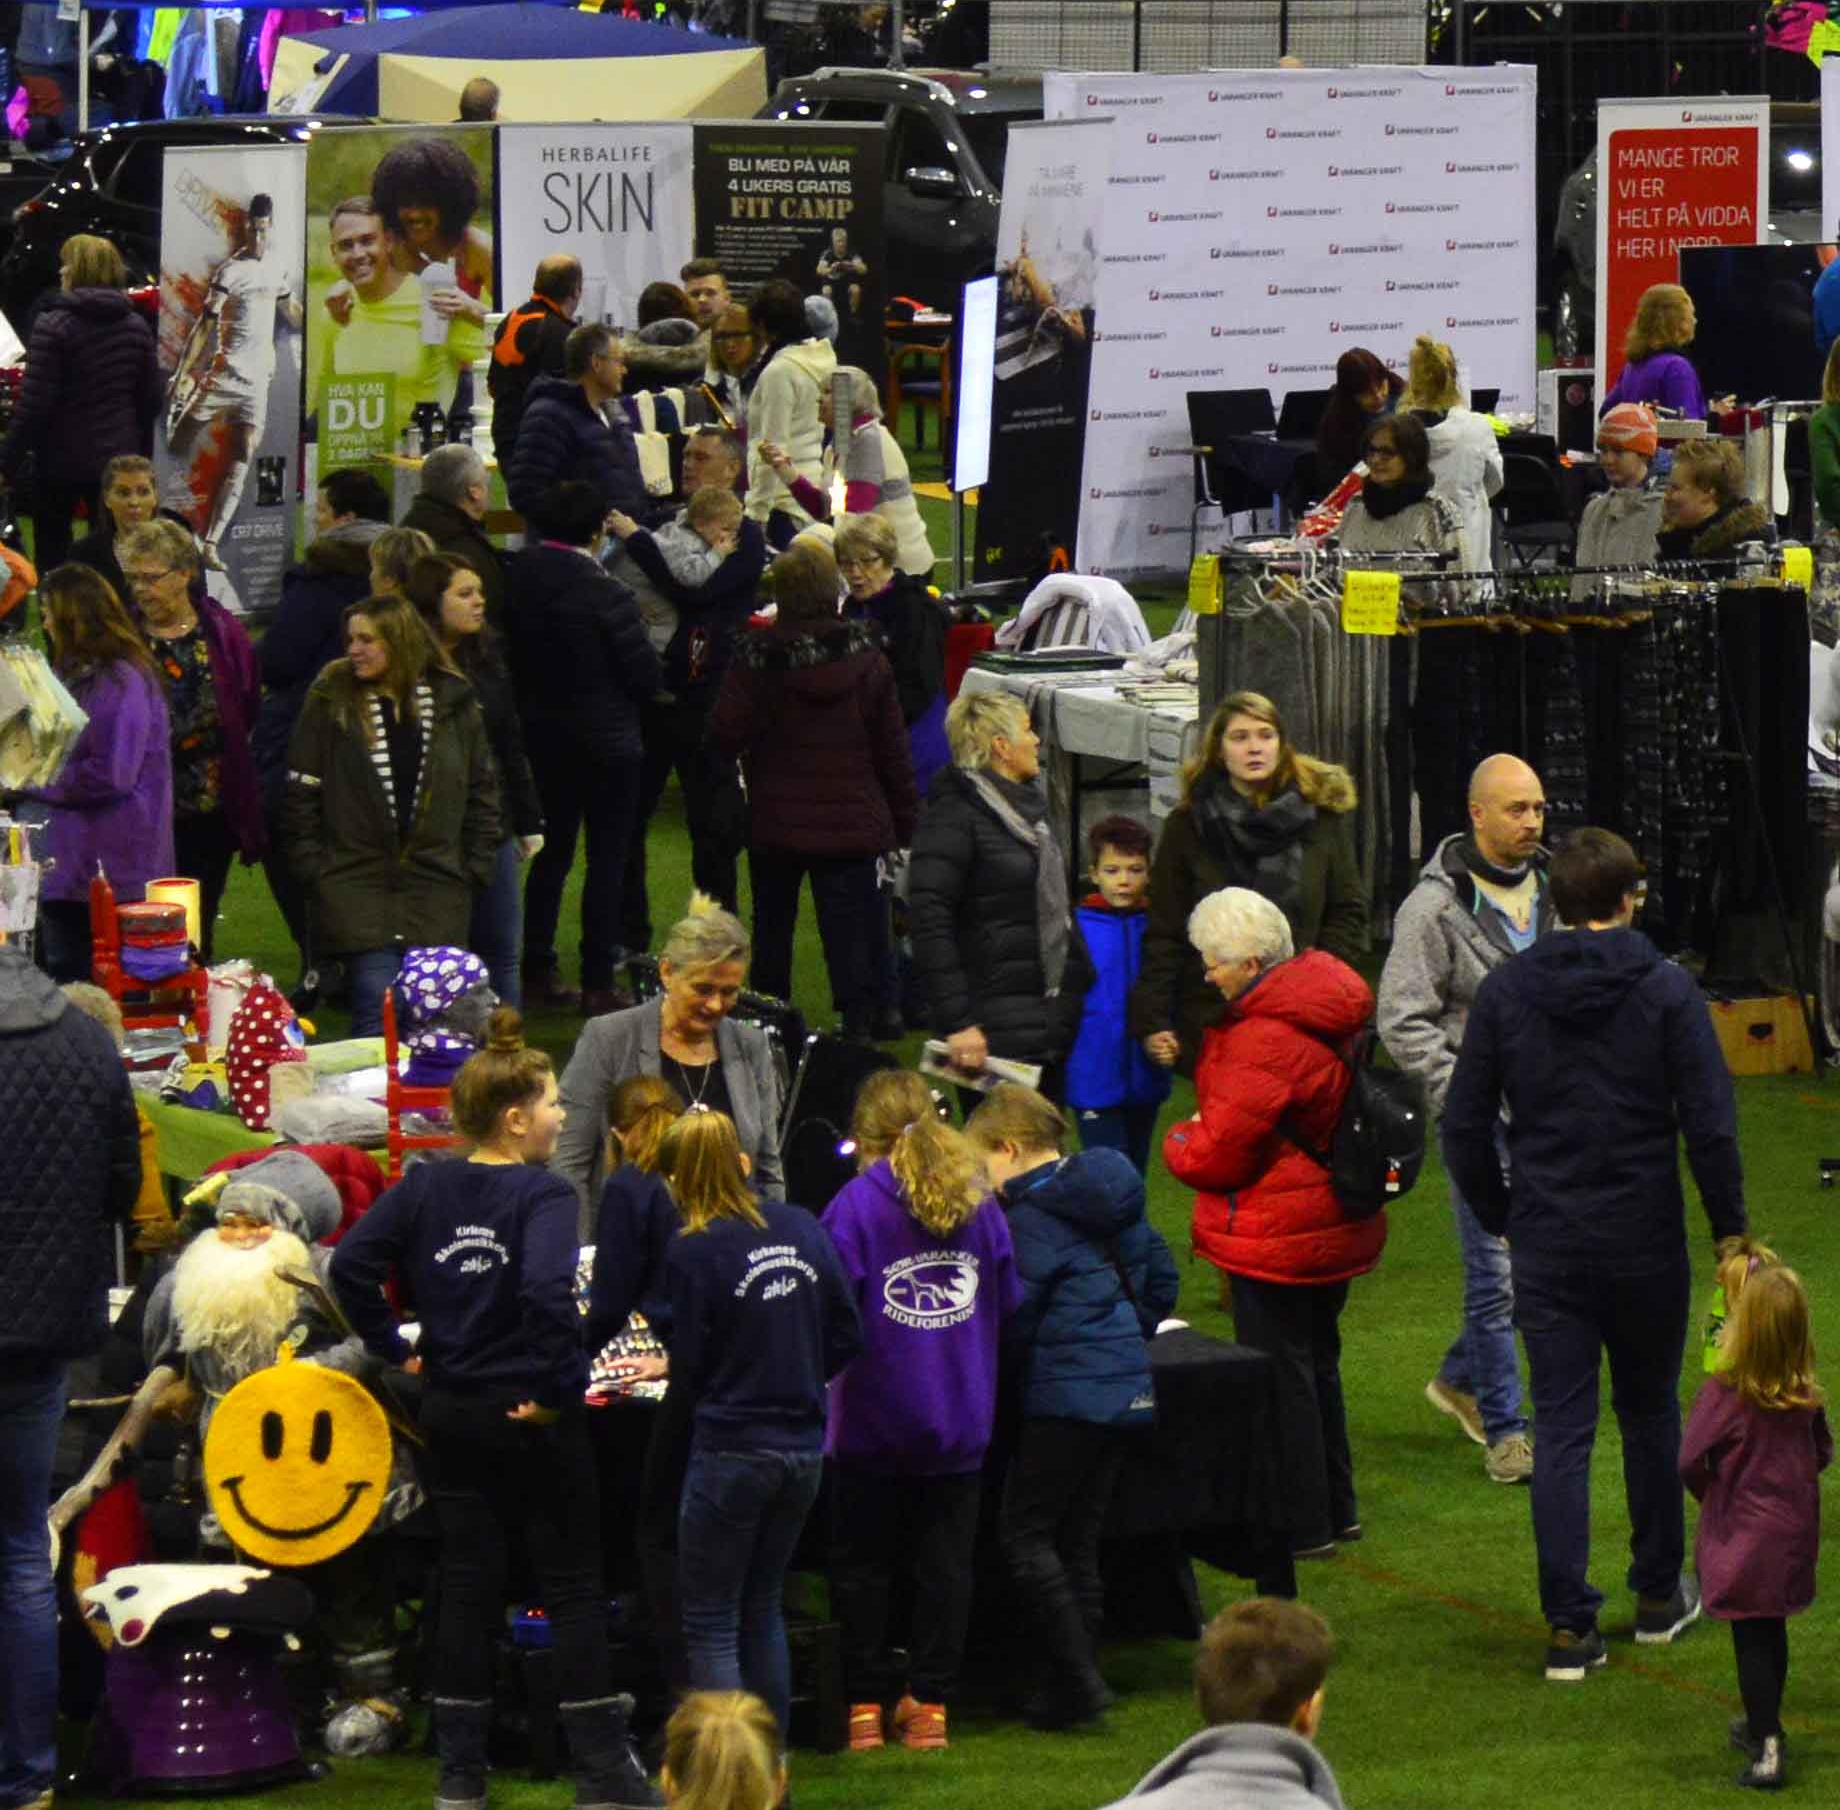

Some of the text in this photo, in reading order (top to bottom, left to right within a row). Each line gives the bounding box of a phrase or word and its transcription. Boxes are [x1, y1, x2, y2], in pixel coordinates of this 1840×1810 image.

[542, 145, 652, 164] HERBALIFE
[728, 156, 850, 174] BLI MED PÅ VÅR
[1617, 146, 1740, 169] MANGE TROR
[727, 178, 852, 195] 4 UKERS GRATIS
[1618, 178, 1665, 199] VI ER
[543, 171, 655, 235] SKIN
[730, 196, 855, 220] FIT CAMP
[1617, 201, 1752, 229] HELT PÅ VIDDA
[1616, 237, 1655, 259] HER
[328, 397, 385, 431] DU
[746, 1243, 798, 1265] Kirkenes
[734, 1255, 819, 1298] Skolemusikkorps
